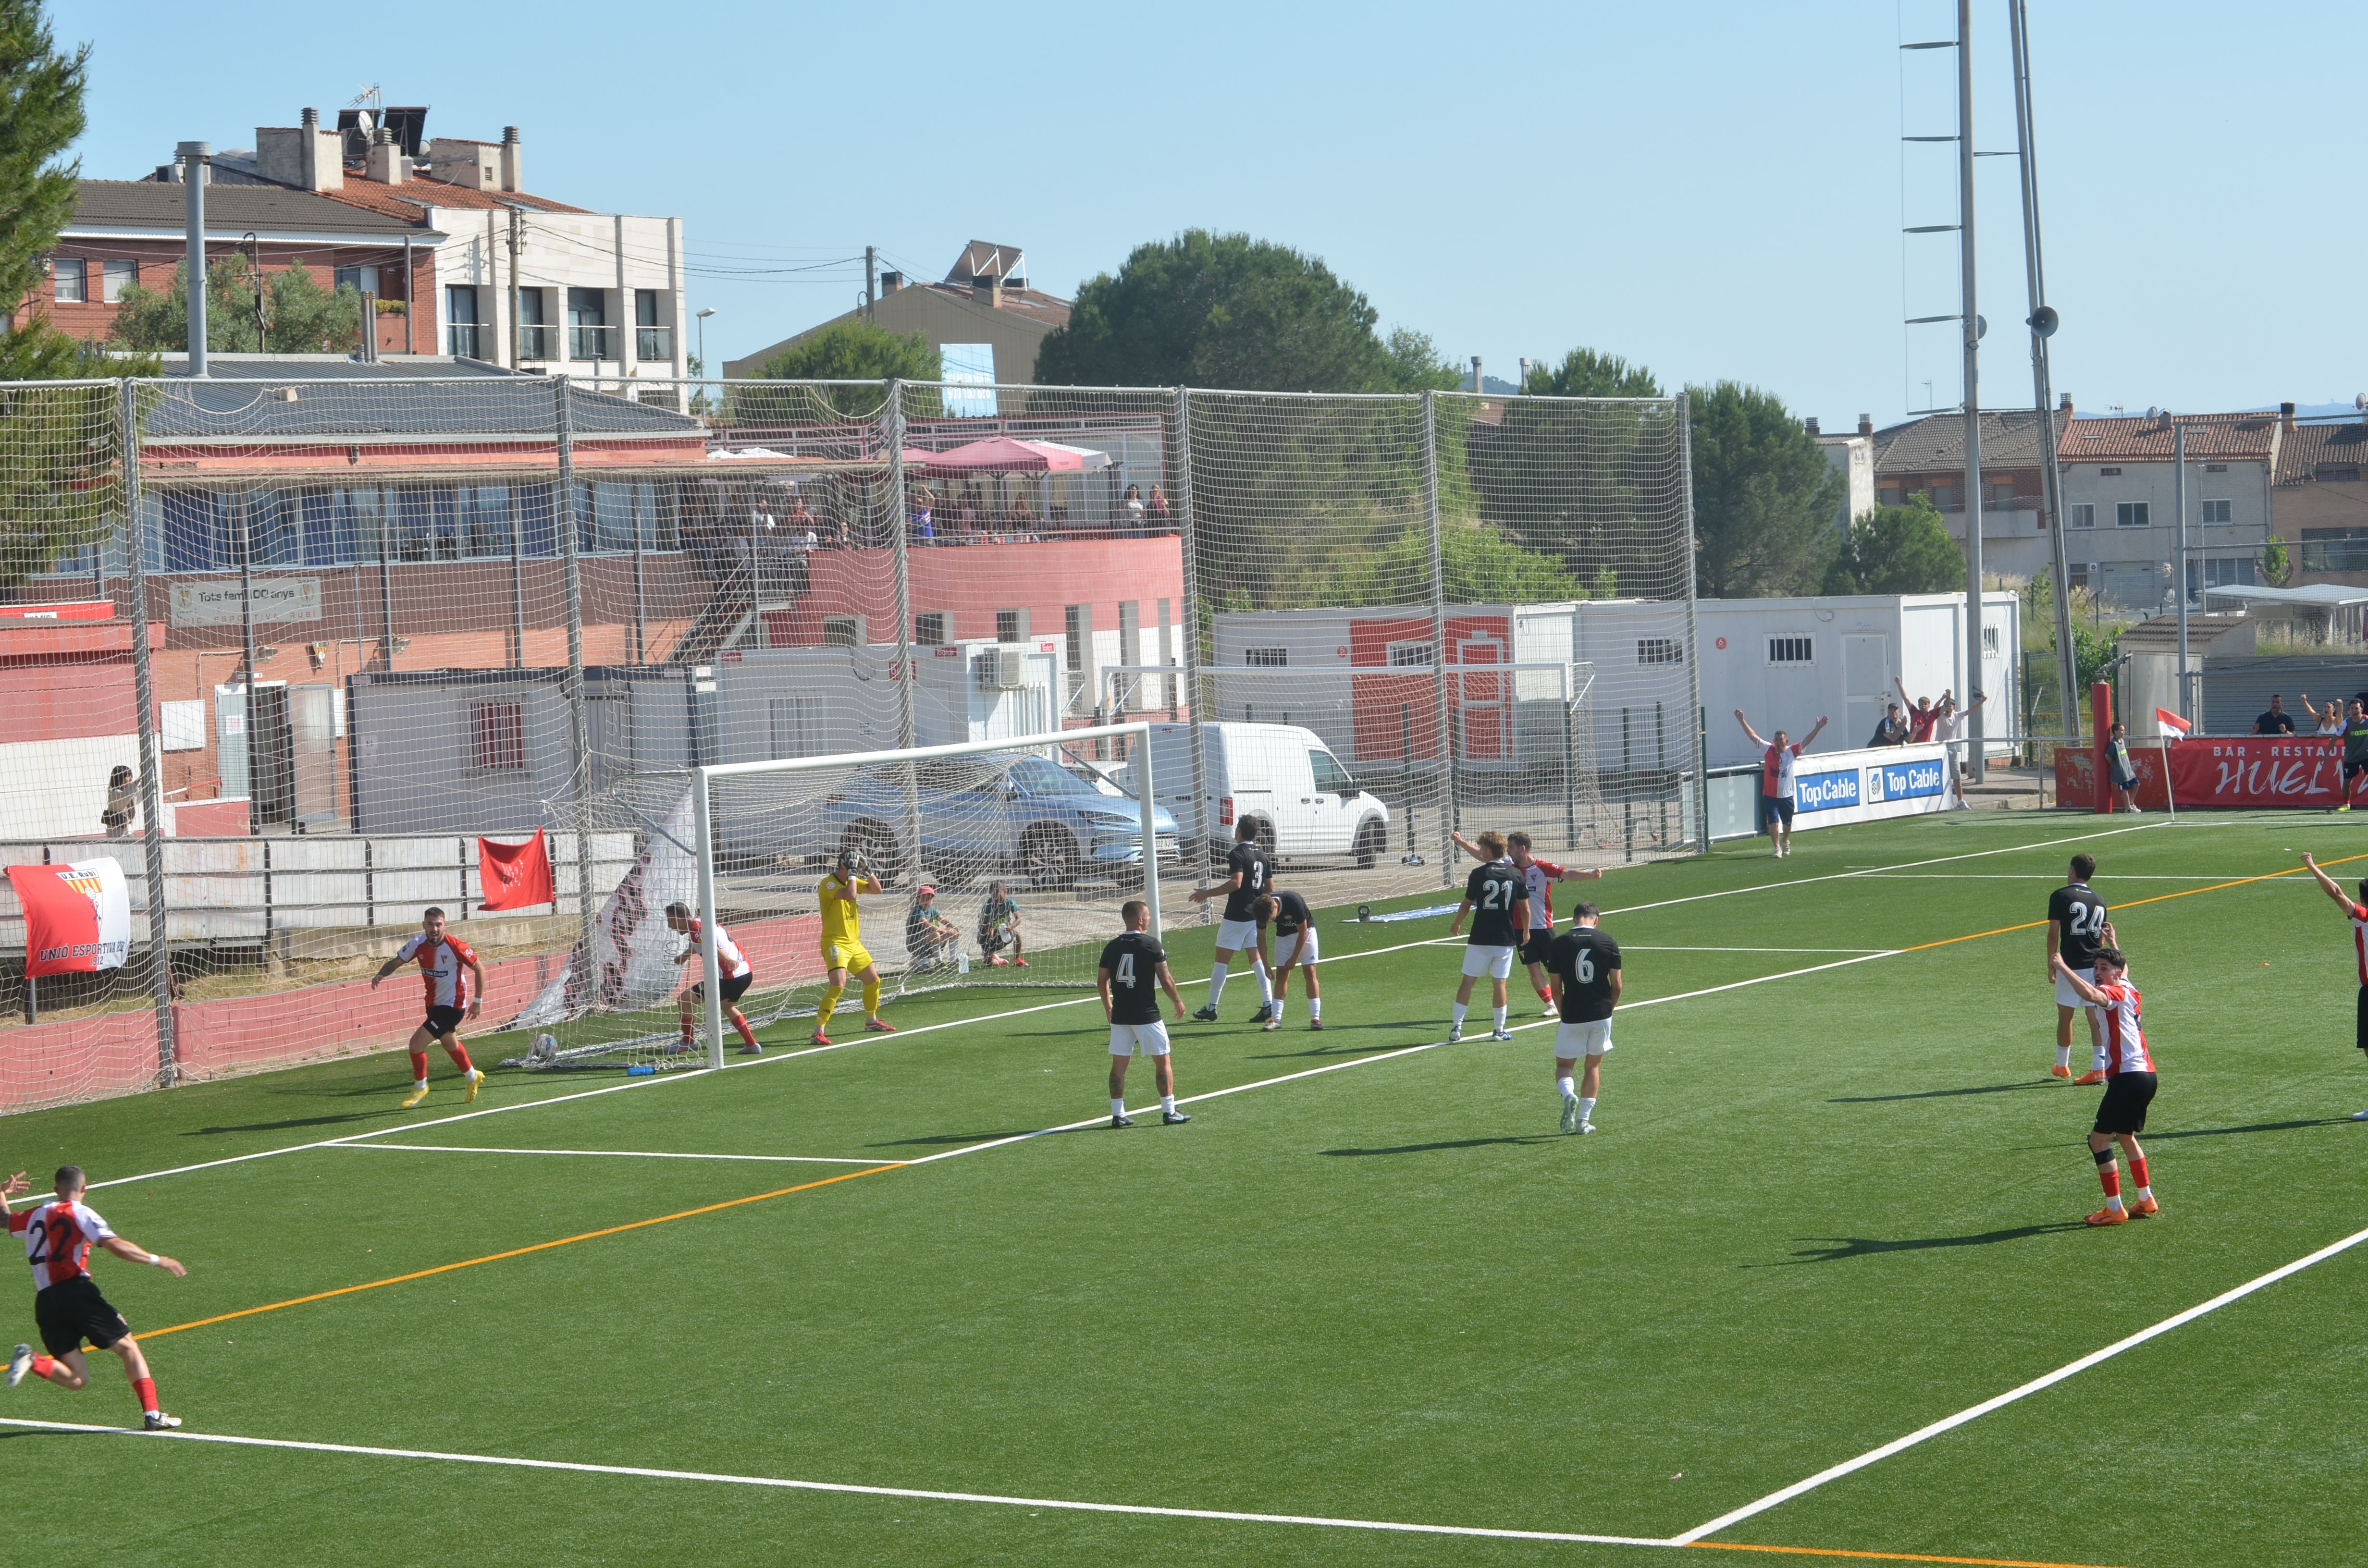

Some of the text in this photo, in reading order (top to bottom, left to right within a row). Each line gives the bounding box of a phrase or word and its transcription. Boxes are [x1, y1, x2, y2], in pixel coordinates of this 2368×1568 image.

[199, 592, 222, 601] Tots
[271, 590, 294, 600] anys
[214, 613, 279, 623] ESPOTIVA
[2213, 747, 2245, 756] BAR
[1799, 778, 1856, 807] Top Cable
[1887, 768, 1940, 796] Top Cable
[1252, 861, 1264, 889] 3
[1483, 880, 1513, 910] 21
[2069, 901, 2105, 938] 24
[40, 943, 68, 961] UNIÓ
[72, 942, 115, 957] ESPORTIVA
[90, 956, 103, 966] 1912
[1116, 953, 1136, 988] 4
[1575, 948, 1594, 984] 6
[29, 1218, 71, 1265] 22
